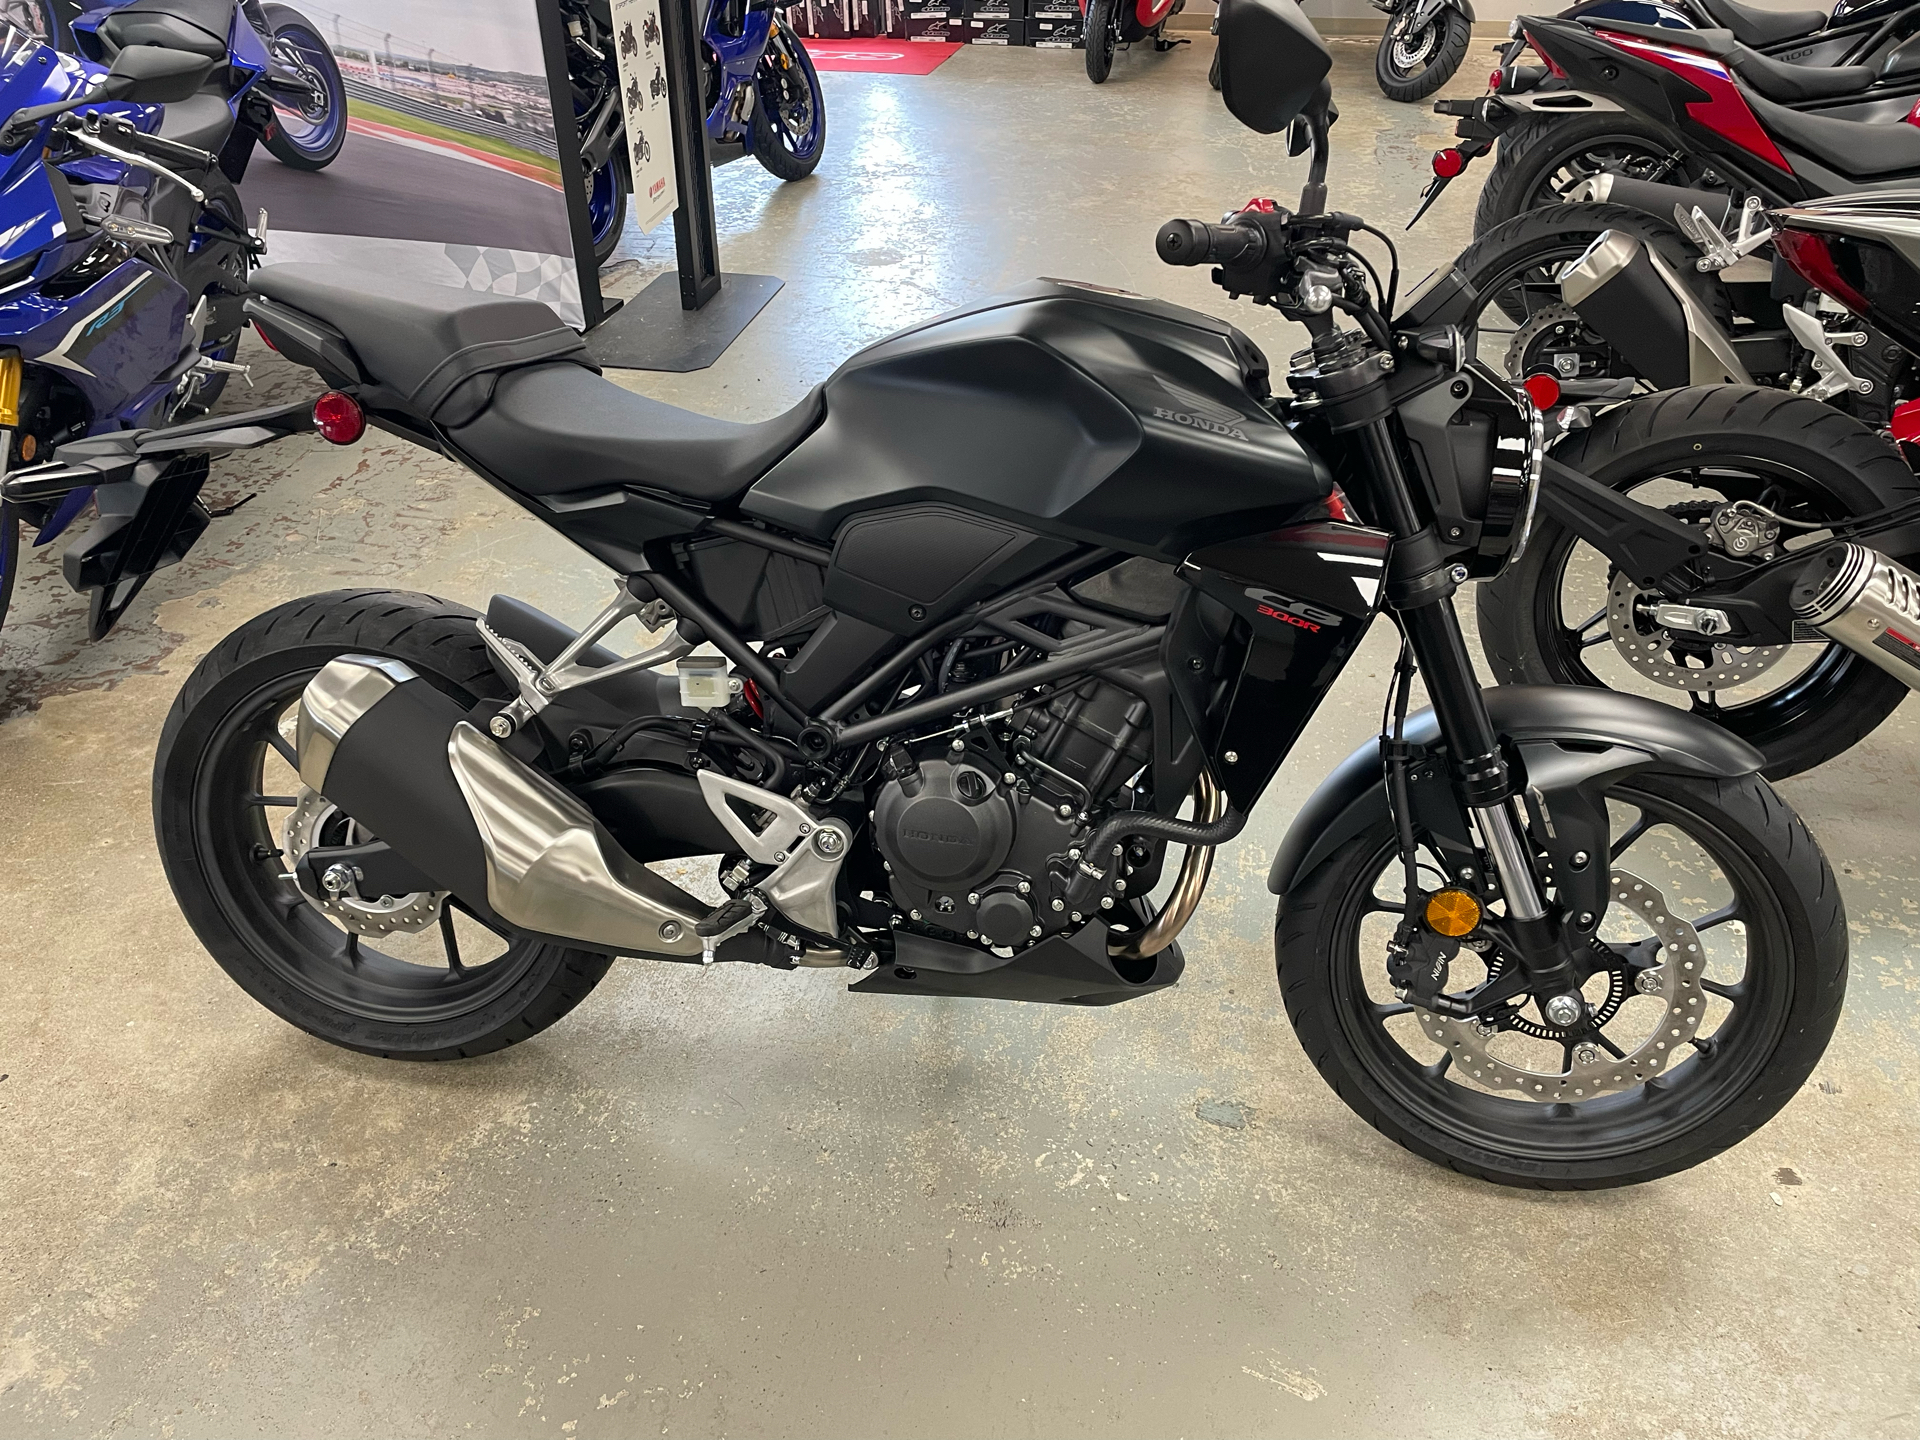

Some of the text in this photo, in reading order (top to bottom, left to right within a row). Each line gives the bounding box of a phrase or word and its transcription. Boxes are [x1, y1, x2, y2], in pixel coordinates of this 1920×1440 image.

[86, 298, 127, 337] R3
[1154, 407, 1248, 441] HONDA
[1244, 587, 1342, 626] CB
[1257, 604, 1321, 633] 300R
[1531, 784, 1556, 838] ABS
[903, 829, 974, 847] HONDA
